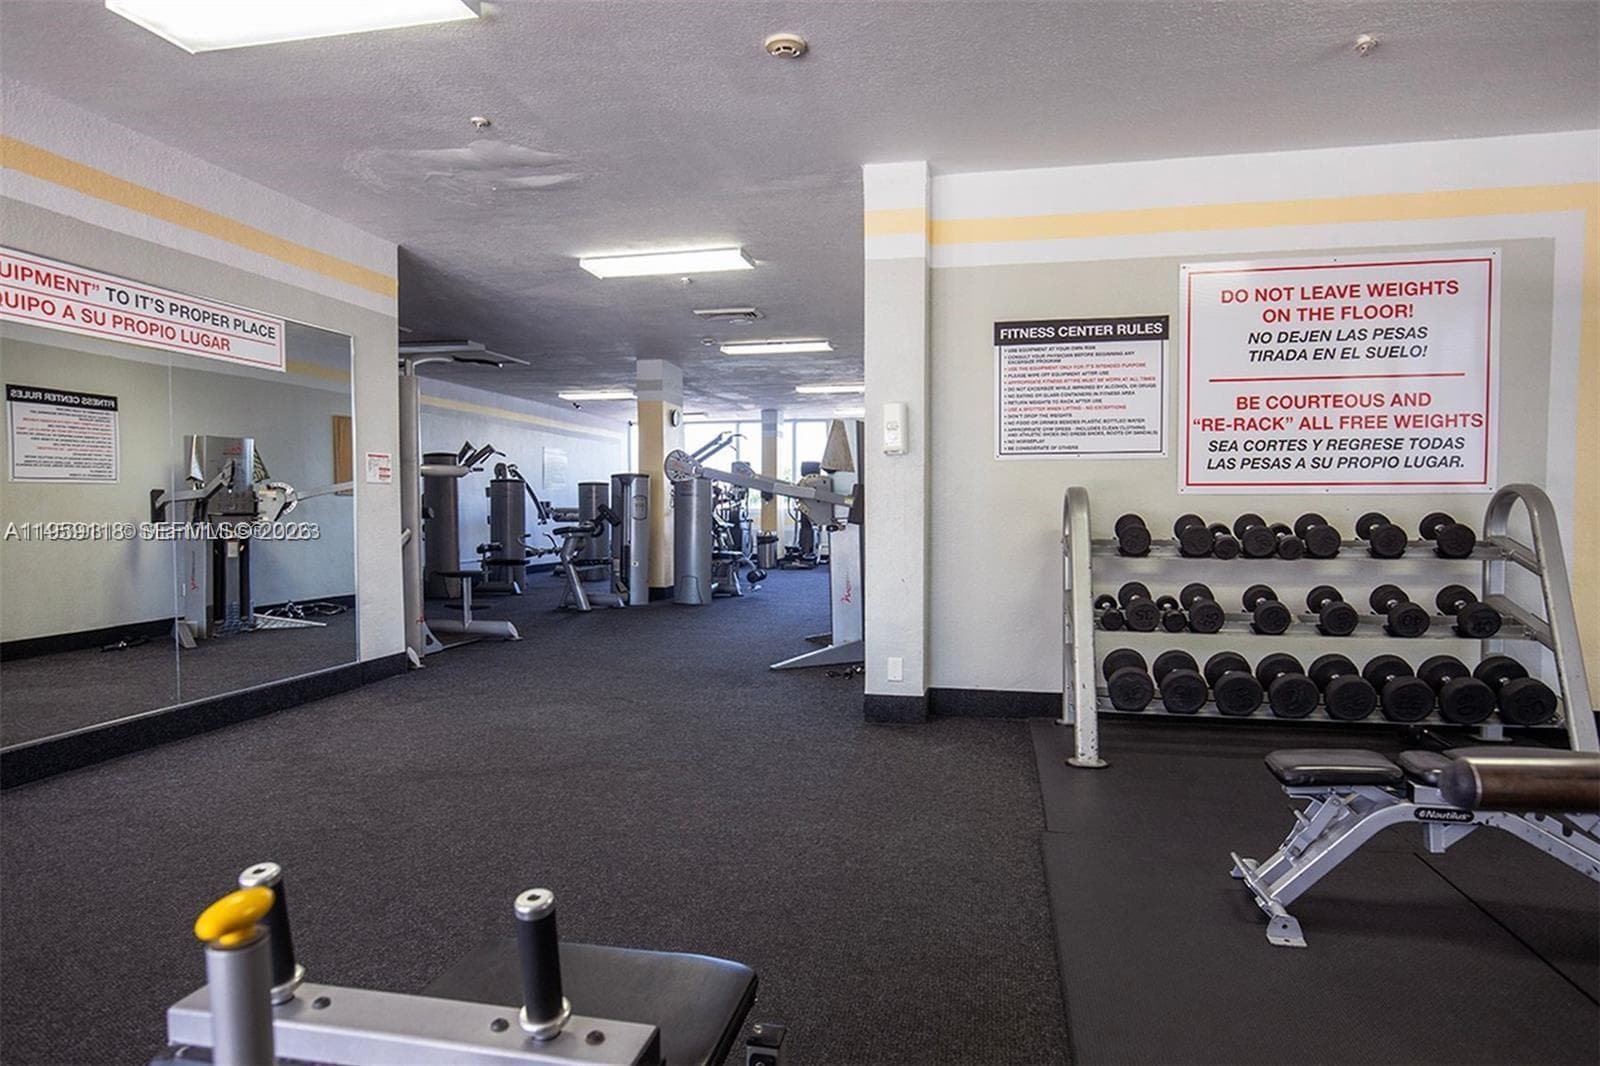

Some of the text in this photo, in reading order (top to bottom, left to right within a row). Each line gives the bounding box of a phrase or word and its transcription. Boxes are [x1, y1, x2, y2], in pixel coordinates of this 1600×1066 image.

[1221, 280, 1459, 303] DO NOT LEAVE WEIGHTS
[0, 291, 230, 351] UIPO A SU PROPIO LUGAR
[105, 287, 129, 305] TO
[169, 303, 230, 328] PROPER
[233, 318, 276, 339] PLACE
[1263, 304, 1413, 323] ON THE FLOOR!
[1000, 323, 1163, 339] FITNESS CENTER RULES
[1248, 327, 1428, 344] NO DEJEN LAS PESAS
[1249, 345, 1427, 362] TIRADA EN EL SUELO!
[1236, 392, 1431, 410] BE COURTEOUS AND
[1299, 416, 1333, 430] ALL
[1340, 416, 1387, 429] FREE
[1394, 413, 1483, 427] WEIGHTS
[1209, 437, 1465, 452] SEA CORTES Y REGRESE TODAS
[1207, 456, 1464, 470] LAS PESAS A SU PROPIO LUGAR.
